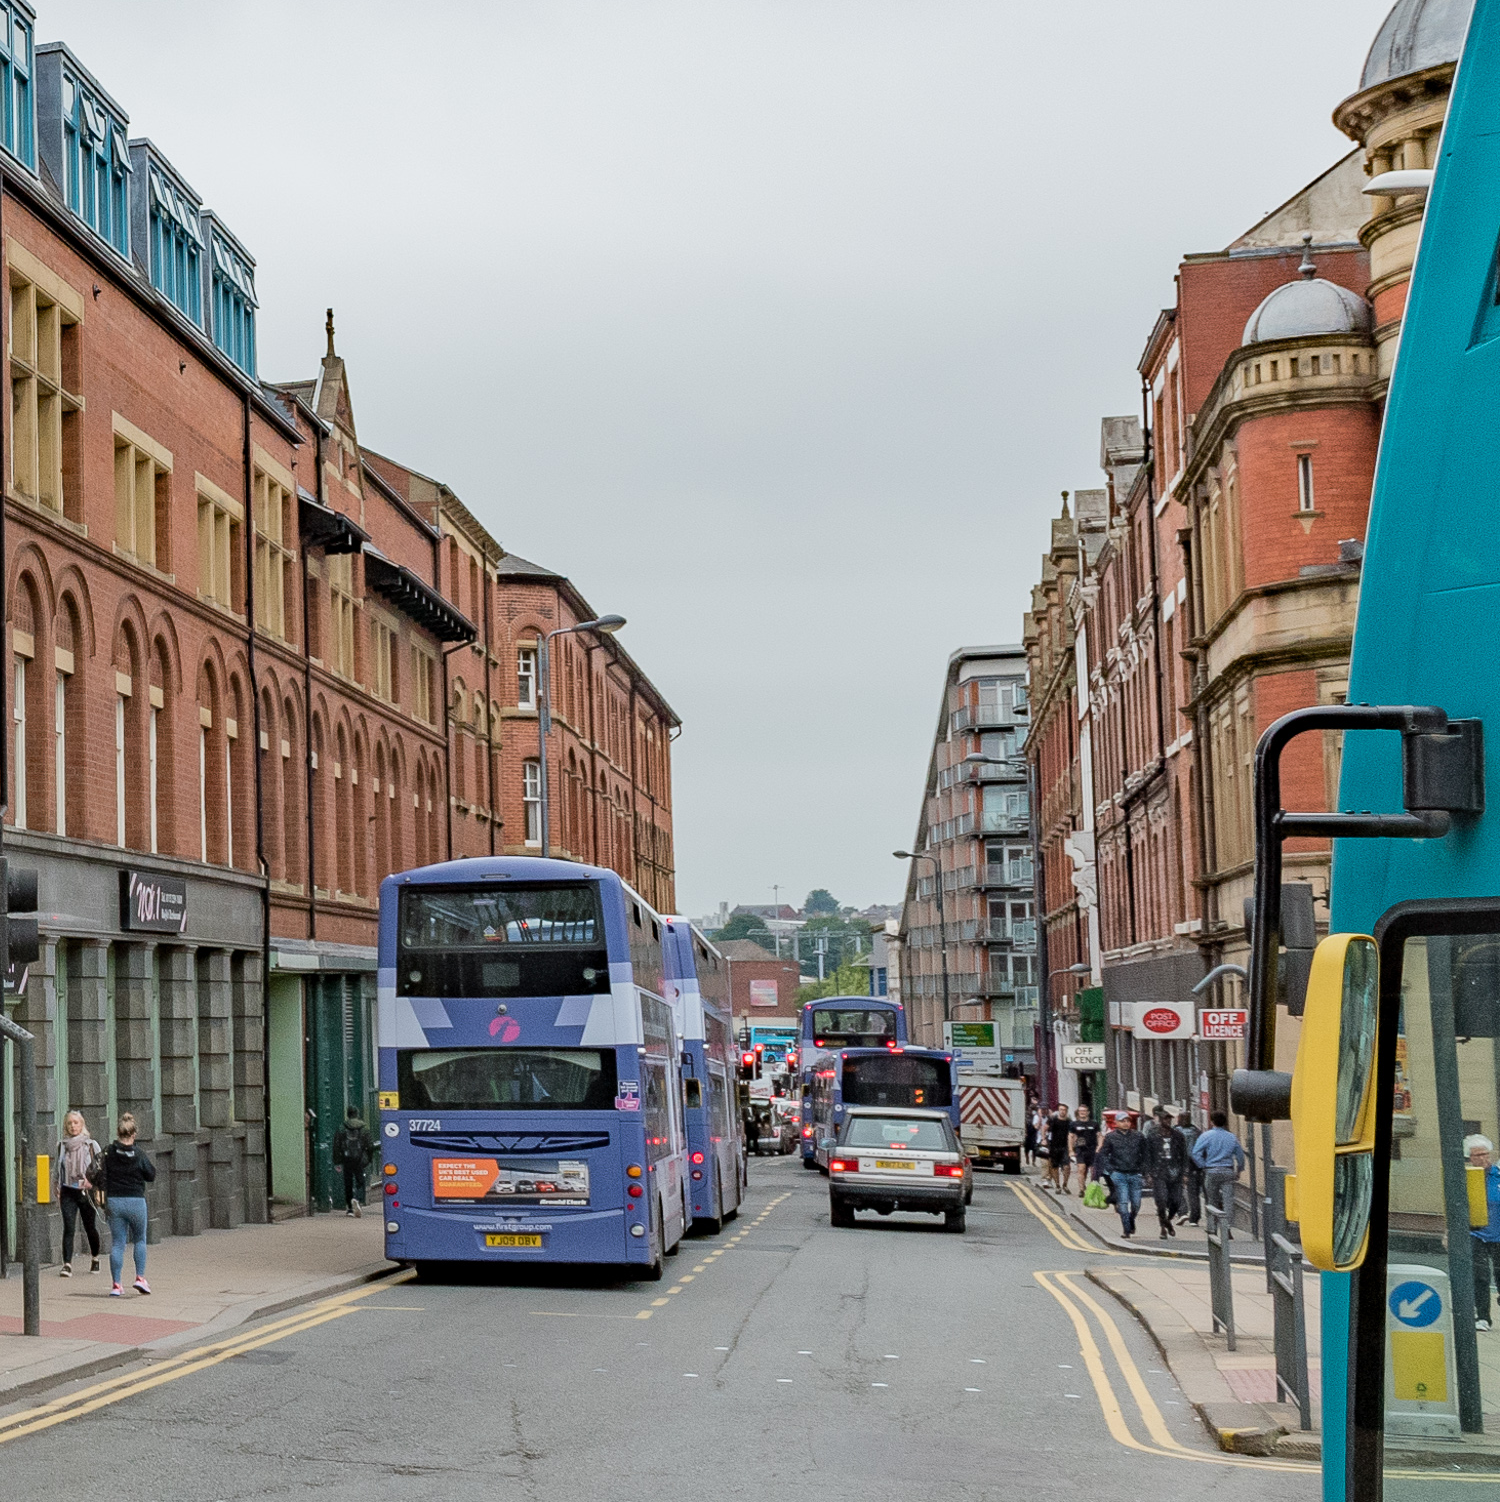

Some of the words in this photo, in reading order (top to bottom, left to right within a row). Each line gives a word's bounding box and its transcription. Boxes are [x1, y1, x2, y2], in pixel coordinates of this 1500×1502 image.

[1150, 1012, 1173, 1020] POST
[1208, 1013, 1239, 1025] OFF
[1205, 1025, 1244, 1037] LICENCE
[1075, 1047, 1093, 1055] OFF
[1065, 1056, 1104, 1064] LICENCE
[409, 1119, 441, 1132] 37724
[473, 1223, 553, 1232] www.firstgroup.com
